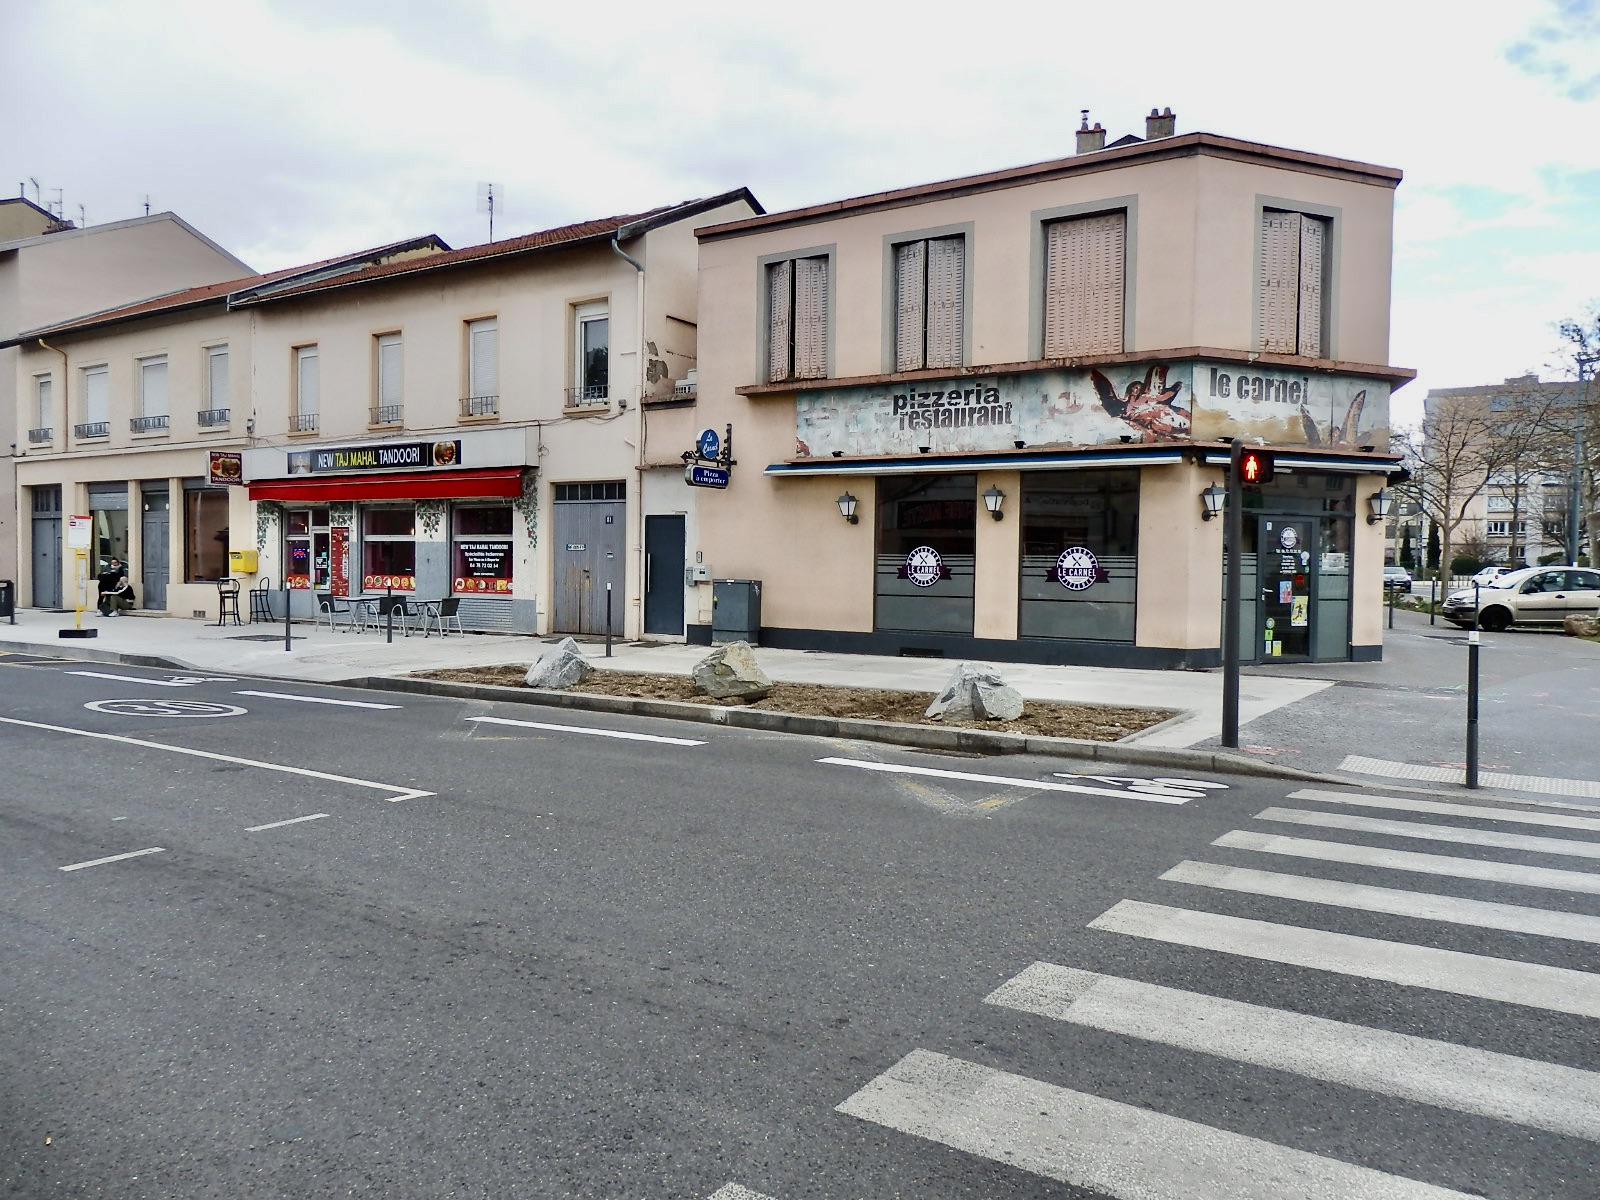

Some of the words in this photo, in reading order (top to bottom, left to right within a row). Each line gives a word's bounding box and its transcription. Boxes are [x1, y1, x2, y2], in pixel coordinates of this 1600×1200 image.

[1209, 367, 1231, 399] le
[893, 382, 1000, 416] pizzeria
[899, 401, 1013, 431] restaurant
[318, 453, 334, 467] NEW
[335, 451, 349, 466] TAJ
[350, 450, 378, 466] MAHAL
[378, 447, 420, 465] TANDOORI
[907, 565, 916, 574] LE
[916, 565, 940, 574] CARNEL
[1057, 568, 1067, 577] LE
[1068, 568, 1097, 577] CARNEL
